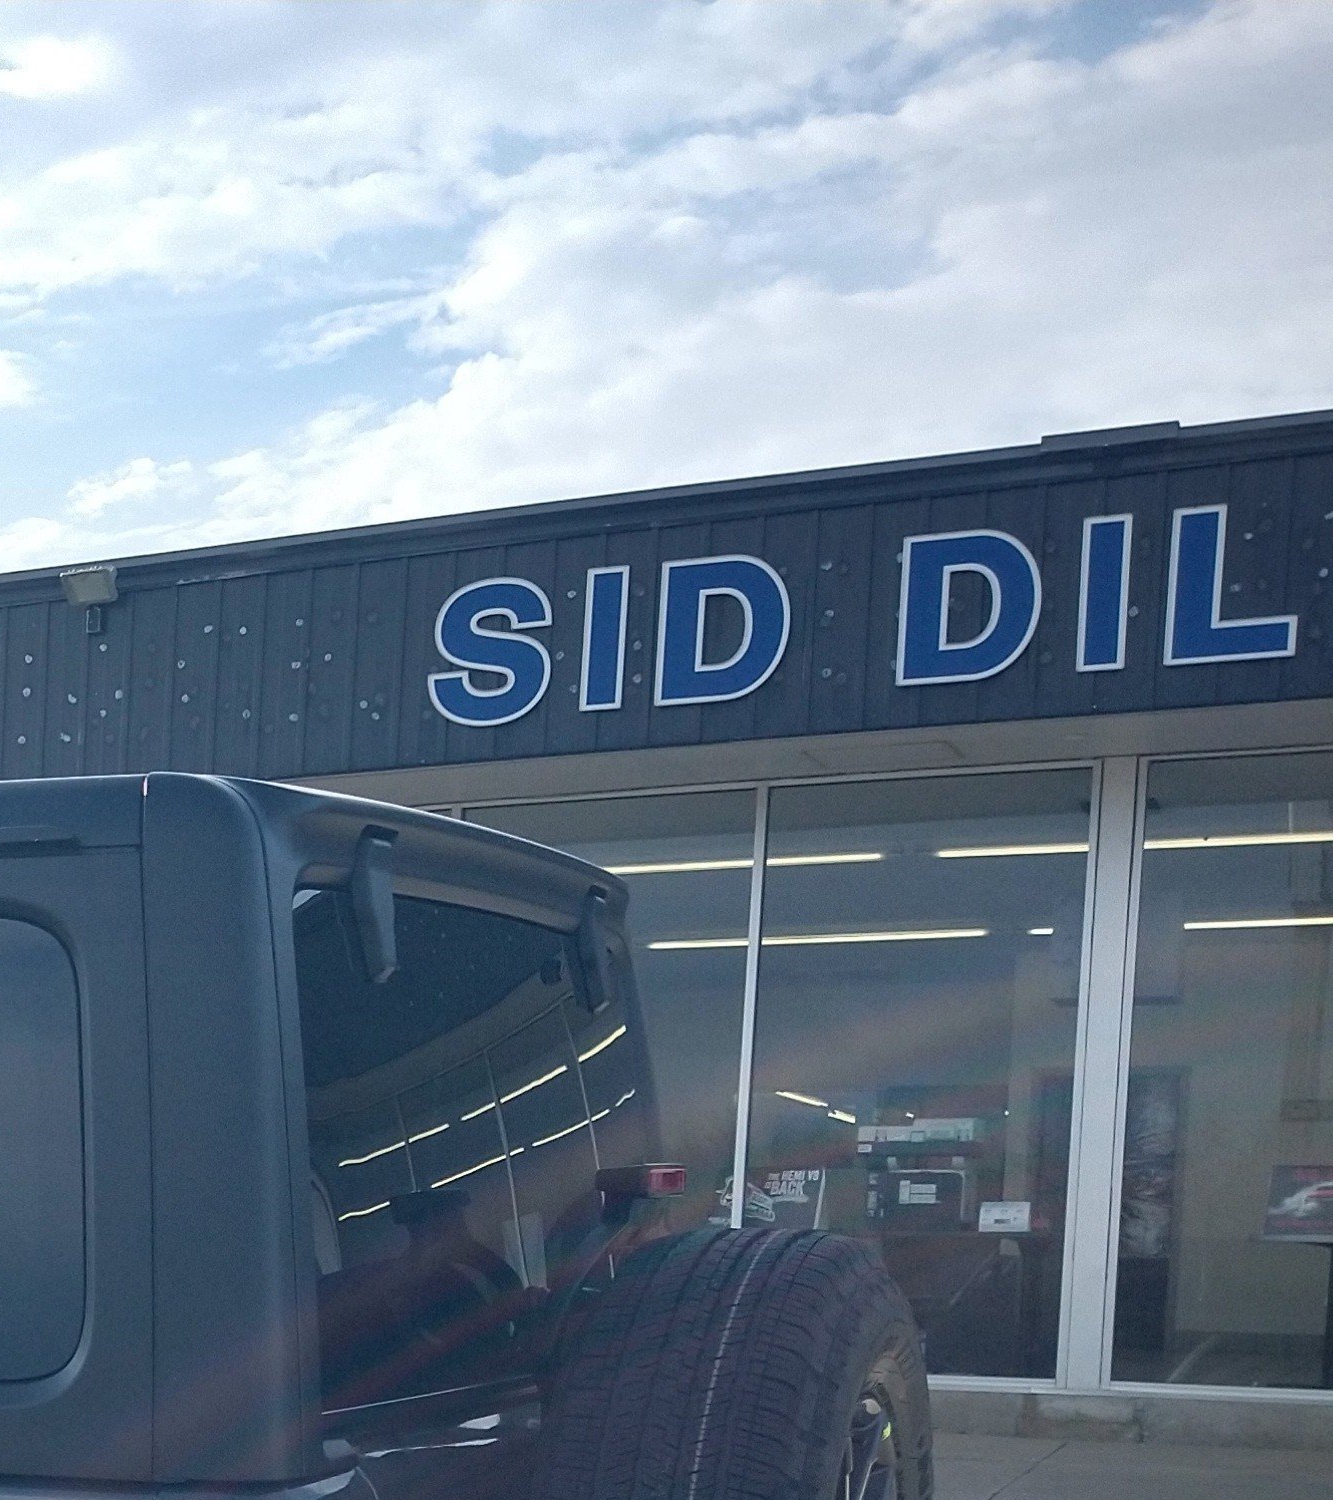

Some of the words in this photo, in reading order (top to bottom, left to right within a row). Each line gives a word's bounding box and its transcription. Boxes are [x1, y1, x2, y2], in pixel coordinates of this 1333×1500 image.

[427, 554, 791, 727] SID
[895, 503, 1299, 687] DIL
[770, 1180, 806, 1196] BACK
